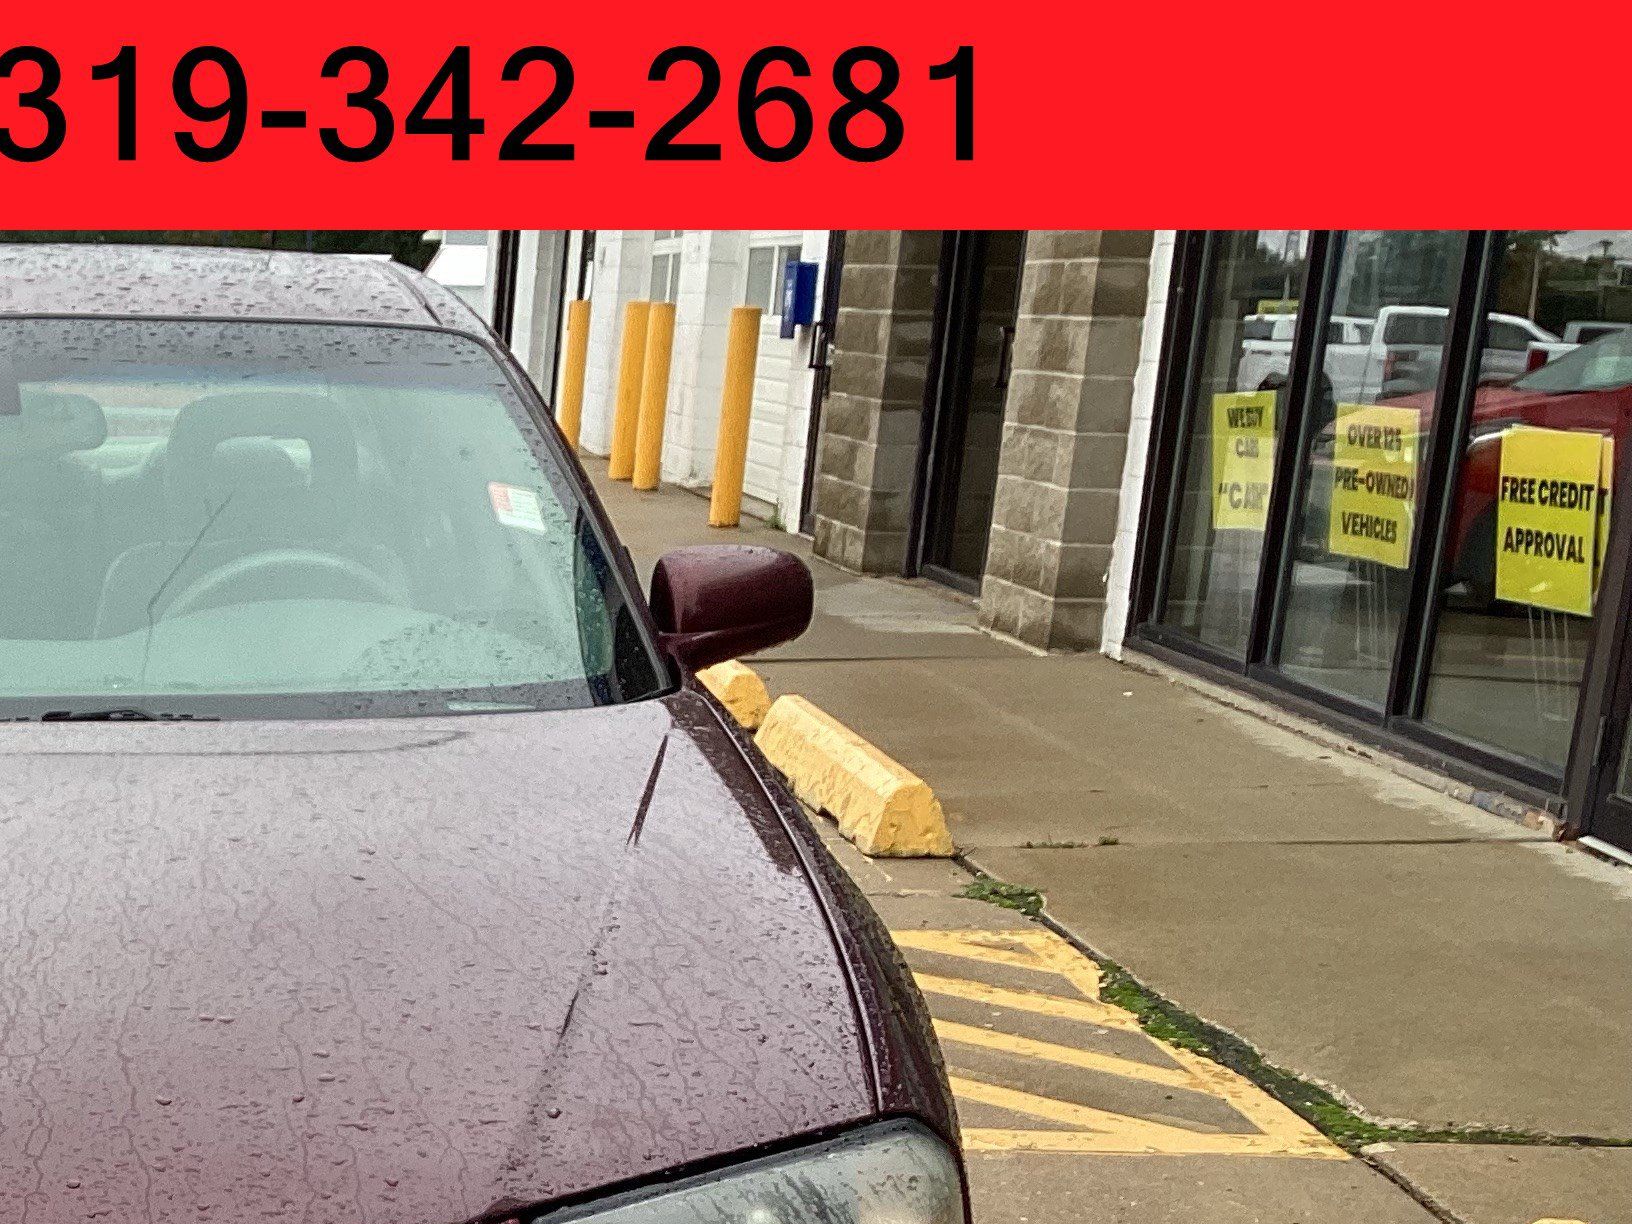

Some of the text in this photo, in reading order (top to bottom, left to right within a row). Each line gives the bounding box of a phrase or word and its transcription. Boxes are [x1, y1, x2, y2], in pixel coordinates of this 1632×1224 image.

[1348, 424, 1381, 449] OVER
[1335, 466, 1409, 499] PRE-OWNED
[1501, 475, 1536, 505] FREE
[1537, 478, 1595, 512] CREDIT
[1341, 510, 1398, 544] VEHICLES
[1502, 526, 1585, 564] APPROVAL
